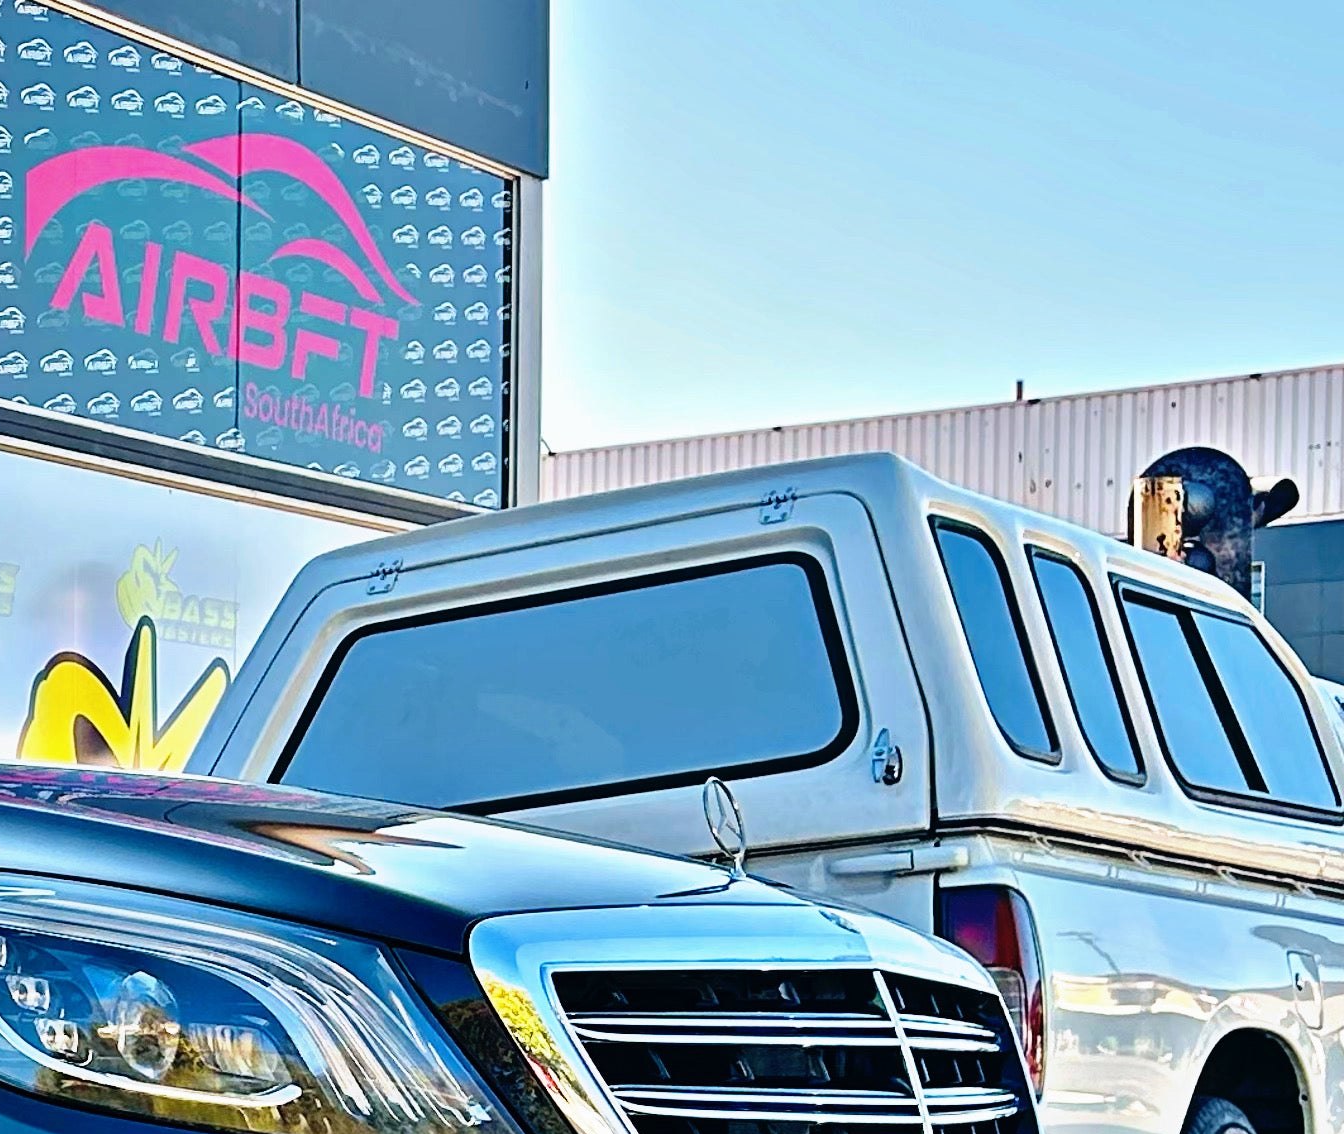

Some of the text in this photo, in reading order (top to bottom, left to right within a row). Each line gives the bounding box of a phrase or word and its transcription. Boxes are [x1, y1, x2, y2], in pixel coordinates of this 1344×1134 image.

[49, 220, 401, 399] AIRBFT
[161, 591, 240, 630] BASS
[160, 622, 235, 651] ASTERS
